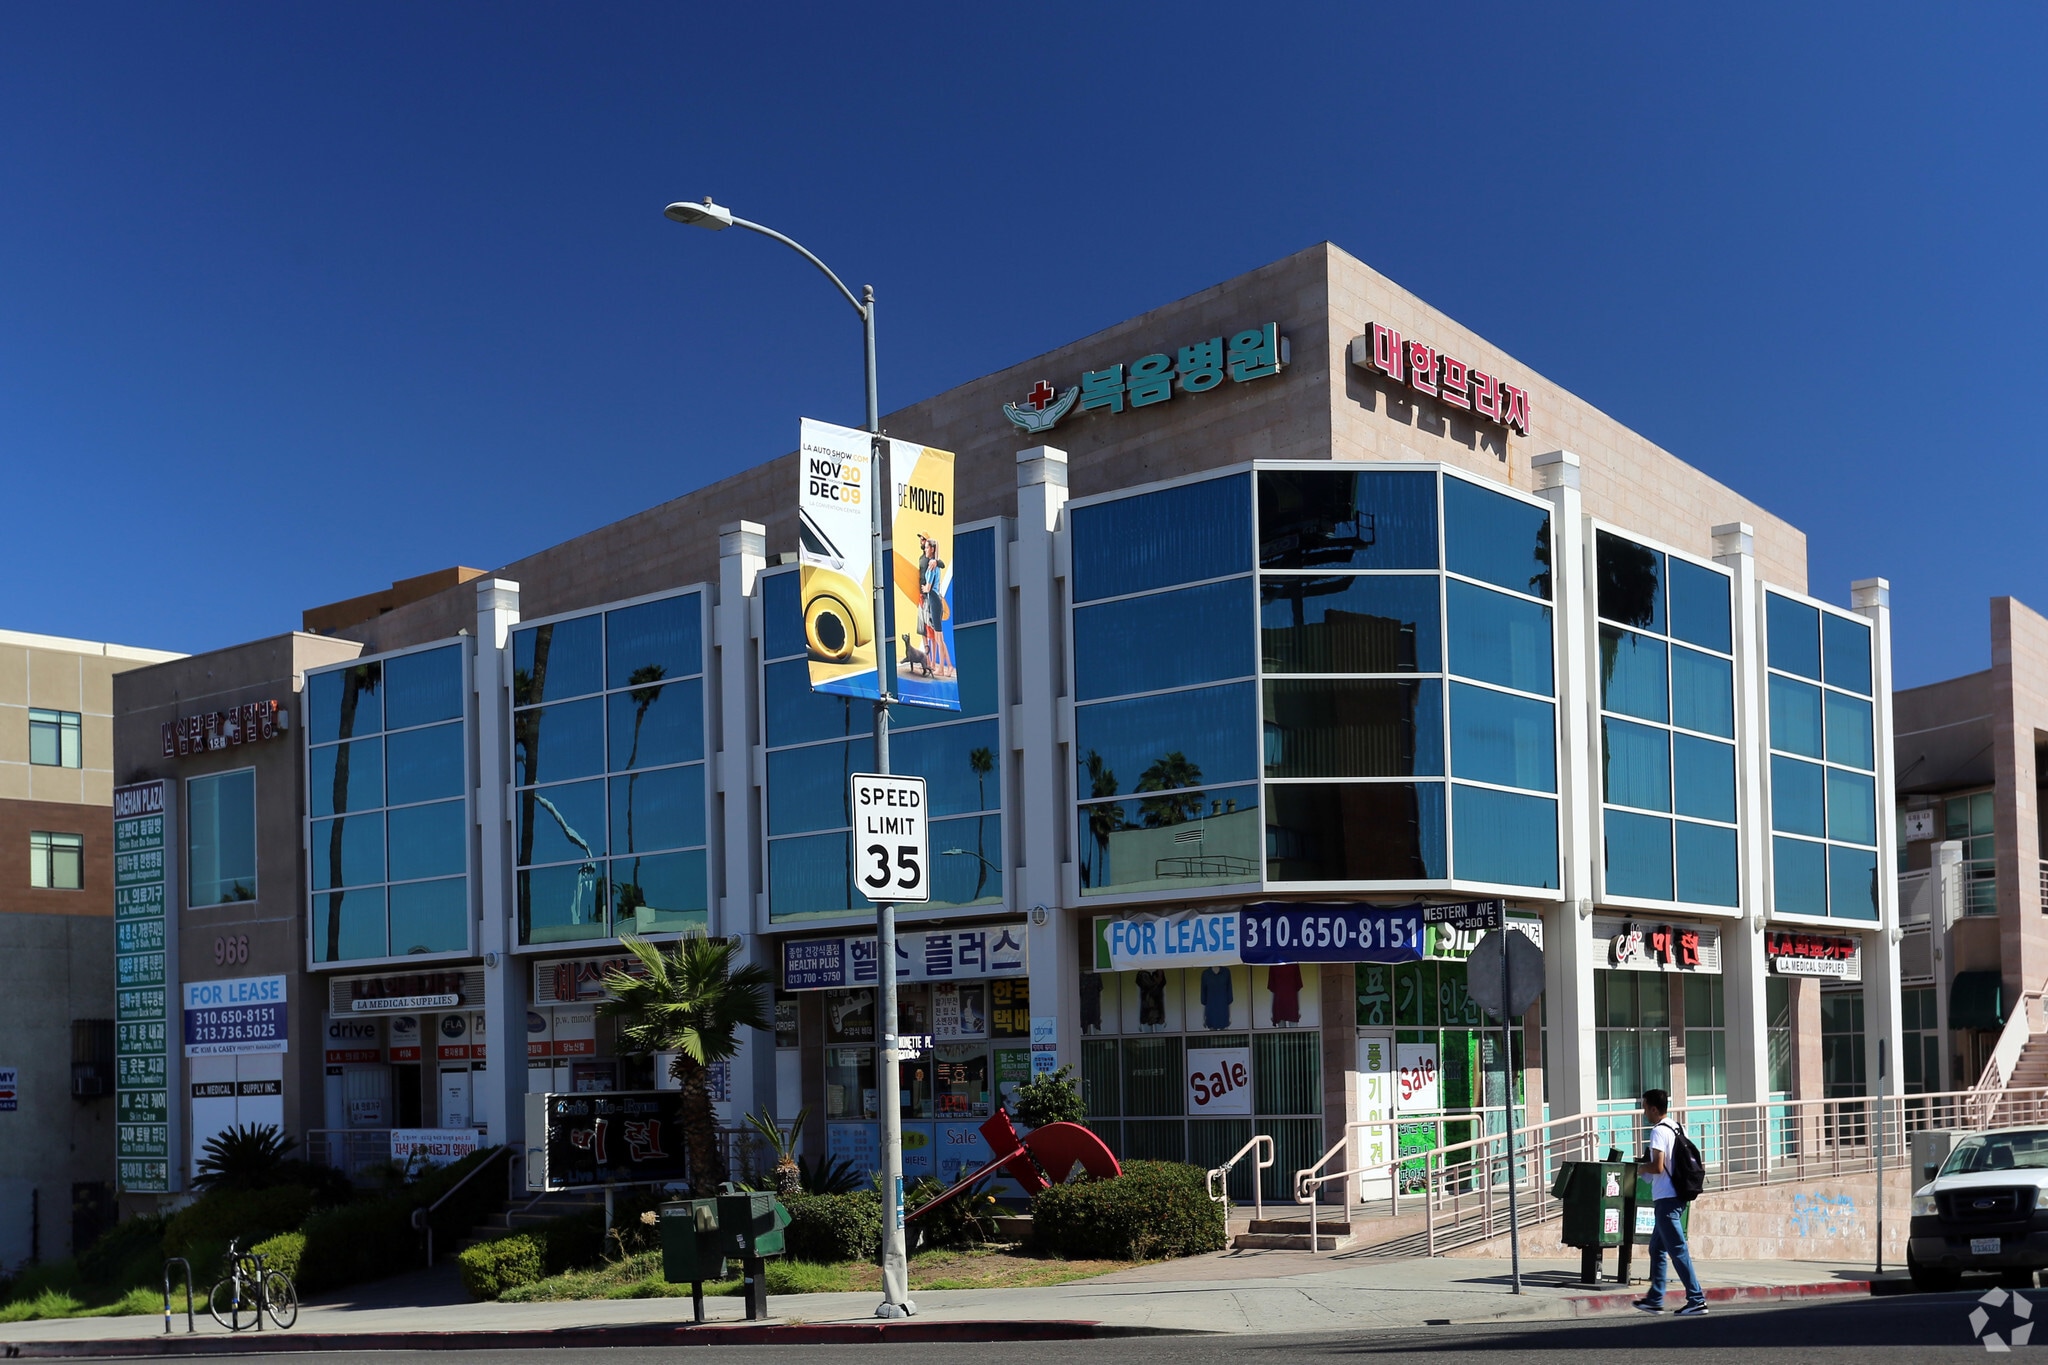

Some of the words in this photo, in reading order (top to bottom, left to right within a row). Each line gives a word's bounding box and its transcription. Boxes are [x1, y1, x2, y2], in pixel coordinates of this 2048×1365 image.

[1080, 322, 1281, 412] 복음병원
[1371, 321, 1530, 436] 대한프라자
[803, 443, 812, 452] LA
[810, 458, 841, 478] NOV
[841, 465, 861, 483] 30
[810, 481, 839, 500] DEC
[840, 487, 861, 504] 09
[898, 482, 908, 508] BE
[909, 485, 945, 516] MOVED
[816, 502, 843, 512] CONVENTION
[844, 507, 861, 515] CENTER
[116, 789, 141, 816] DAEHAN
[142, 786, 164, 812] PLAZA
[860, 787, 920, 808] SPEED
[867, 816, 915, 835] LIMIT
[864, 844, 921, 889] 35
[132, 885, 163, 904] 의료기구
[129, 904, 146, 914] Medical
[146, 903, 161, 914] Supply
[1424, 904, 1468, 921] WESTERN
[1476, 902, 1497, 916] AVE.
[1465, 918, 1483, 928] 900
[1488, 916, 1497, 926] S.
[1112, 922, 1157, 956] FOR
[1164, 916, 1235, 954] LEASE
[1246, 916, 1419, 949] 310.650-8151
[214, 935, 249, 965] 966
[789, 947, 803, 959] 종합
[805, 944, 840, 958] 건강식품점
[925, 929, 1022, 976] 플러스
[789, 959, 817, 971] HEALTH
[819, 957, 839, 969] PLUS
[1780, 960, 1791, 971] L.A.
[1791, 961, 1816, 972] MEDICAL
[1818, 962, 1845, 974] SUPPLIES
[788, 974, 802, 984] (213)
[803, 972, 817, 983] 700
[823, 971, 841, 982] 5750
[191, 985, 223, 1005] FOR
[229, 981, 279, 1002] LEASE
[357, 1001, 368, 1009] LA
[369, 998, 409, 1009] MEDICAL
[411, 996, 453, 1006] SUPPLIES
[196, 1008, 275, 1025] 310.650-8151
[444, 1020, 463, 1029] FLA
[571, 1014, 591, 1024] minor
[148, 1023, 165, 1039] 내과
[196, 1024, 276, 1041] 213.736.5025
[329, 1021, 375, 1038] drive
[775, 1020, 796, 1031] ORDER
[218, 1045, 236, 1053] CASEY
[130, 1058, 146, 1074] 웃는
[148, 1057, 164, 1073] 치과
[1191, 1060, 1248, 1106] Sale
[1400, 1055, 1435, 1101] Sale
[206, 1082, 231, 1095] MEDICAL
[242, 1082, 264, 1094] SUPPLY
[264, 1081, 277, 1093] INC.
[134, 1093, 149, 1109] 스킨
[940, 1094, 967, 1113] OPEN
[129, 1111, 141, 1121] Skin
[142, 1111, 156, 1121] Care
[121, 1127, 135, 1142] 지아
[152, 1127, 166, 1142] 뷰티
[947, 1129, 977, 1146] Sale
[131, 1143, 145, 1152] Total
[146, 1143, 164, 1155] Beauty
